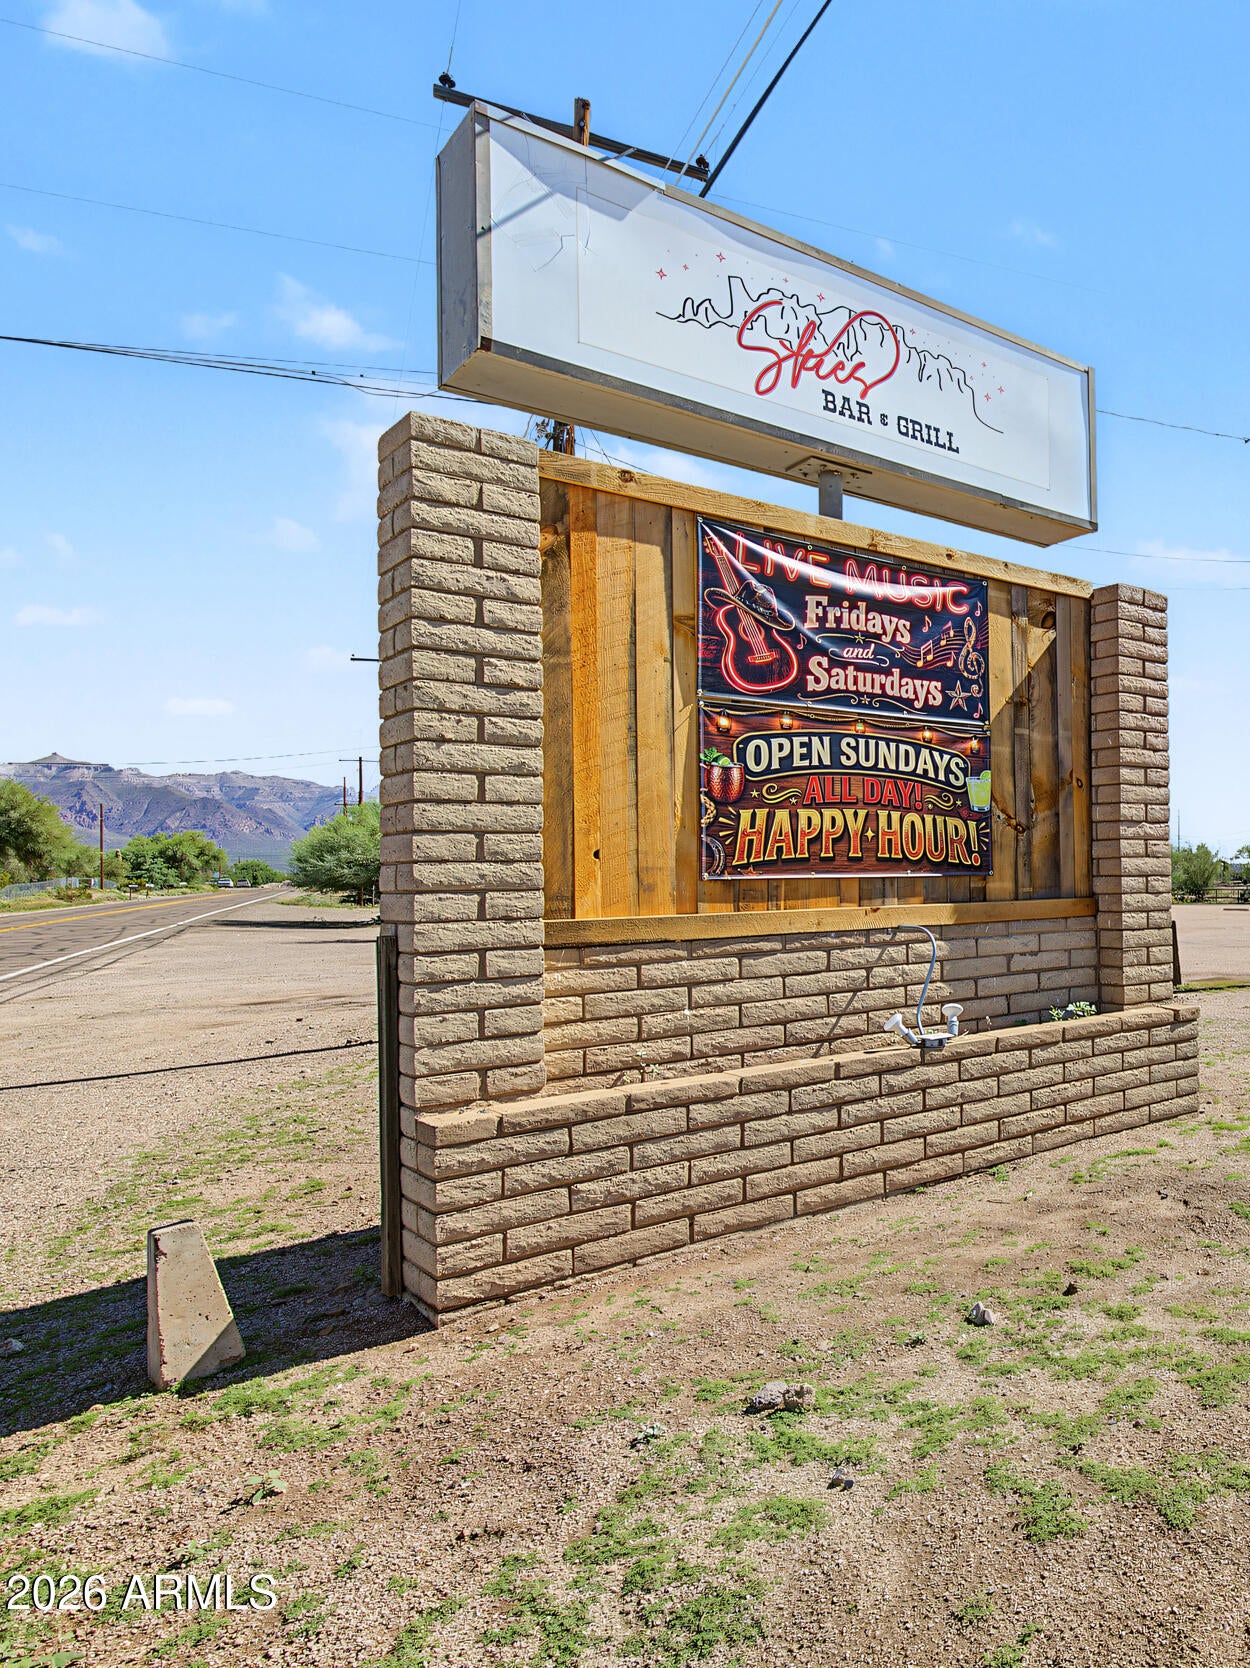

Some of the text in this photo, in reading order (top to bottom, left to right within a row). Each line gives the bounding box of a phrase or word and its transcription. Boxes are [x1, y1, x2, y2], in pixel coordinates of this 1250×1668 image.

[821, 389, 960, 454] BAR & GRILL
[734, 532, 970, 615] LIVE MUSIC
[803, 595, 911, 644] Fridays
[843, 643, 875, 659] and
[805, 655, 943, 709] Saturdays
[745, 735, 967, 787] OPEN SUNDAYS
[802, 775, 924, 810] ALL DAY!
[732, 808, 982, 868] HAPPY HOUR!
